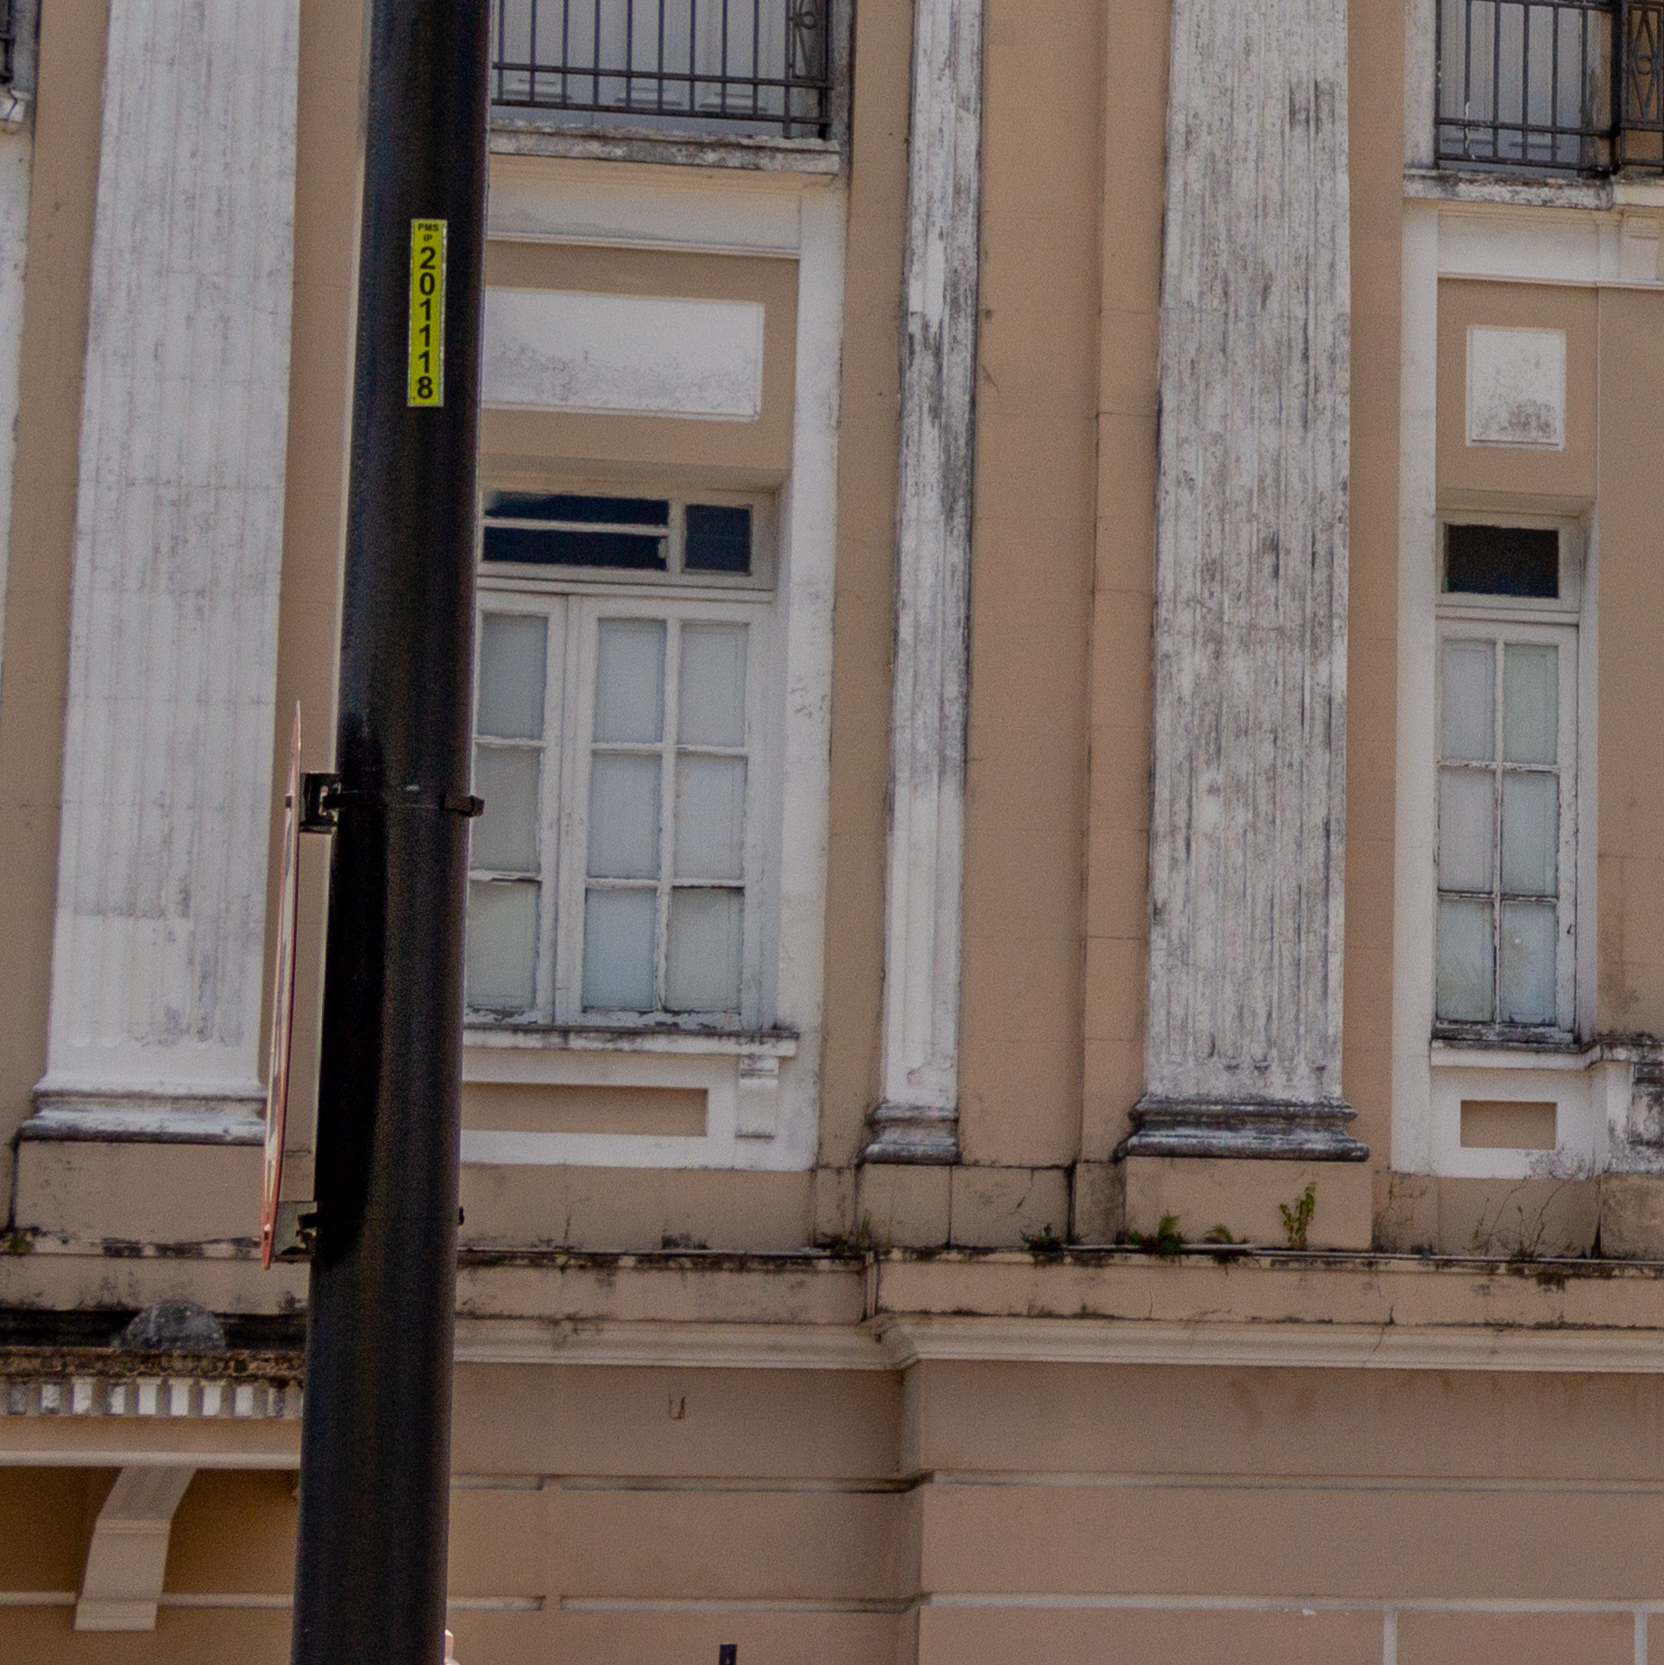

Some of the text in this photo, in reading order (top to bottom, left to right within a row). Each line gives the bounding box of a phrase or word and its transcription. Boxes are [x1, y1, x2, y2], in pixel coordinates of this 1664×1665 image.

[418, 223, 439, 232] PMS
[423, 234, 433, 242] IP
[417, 246, 436, 400] 201118
